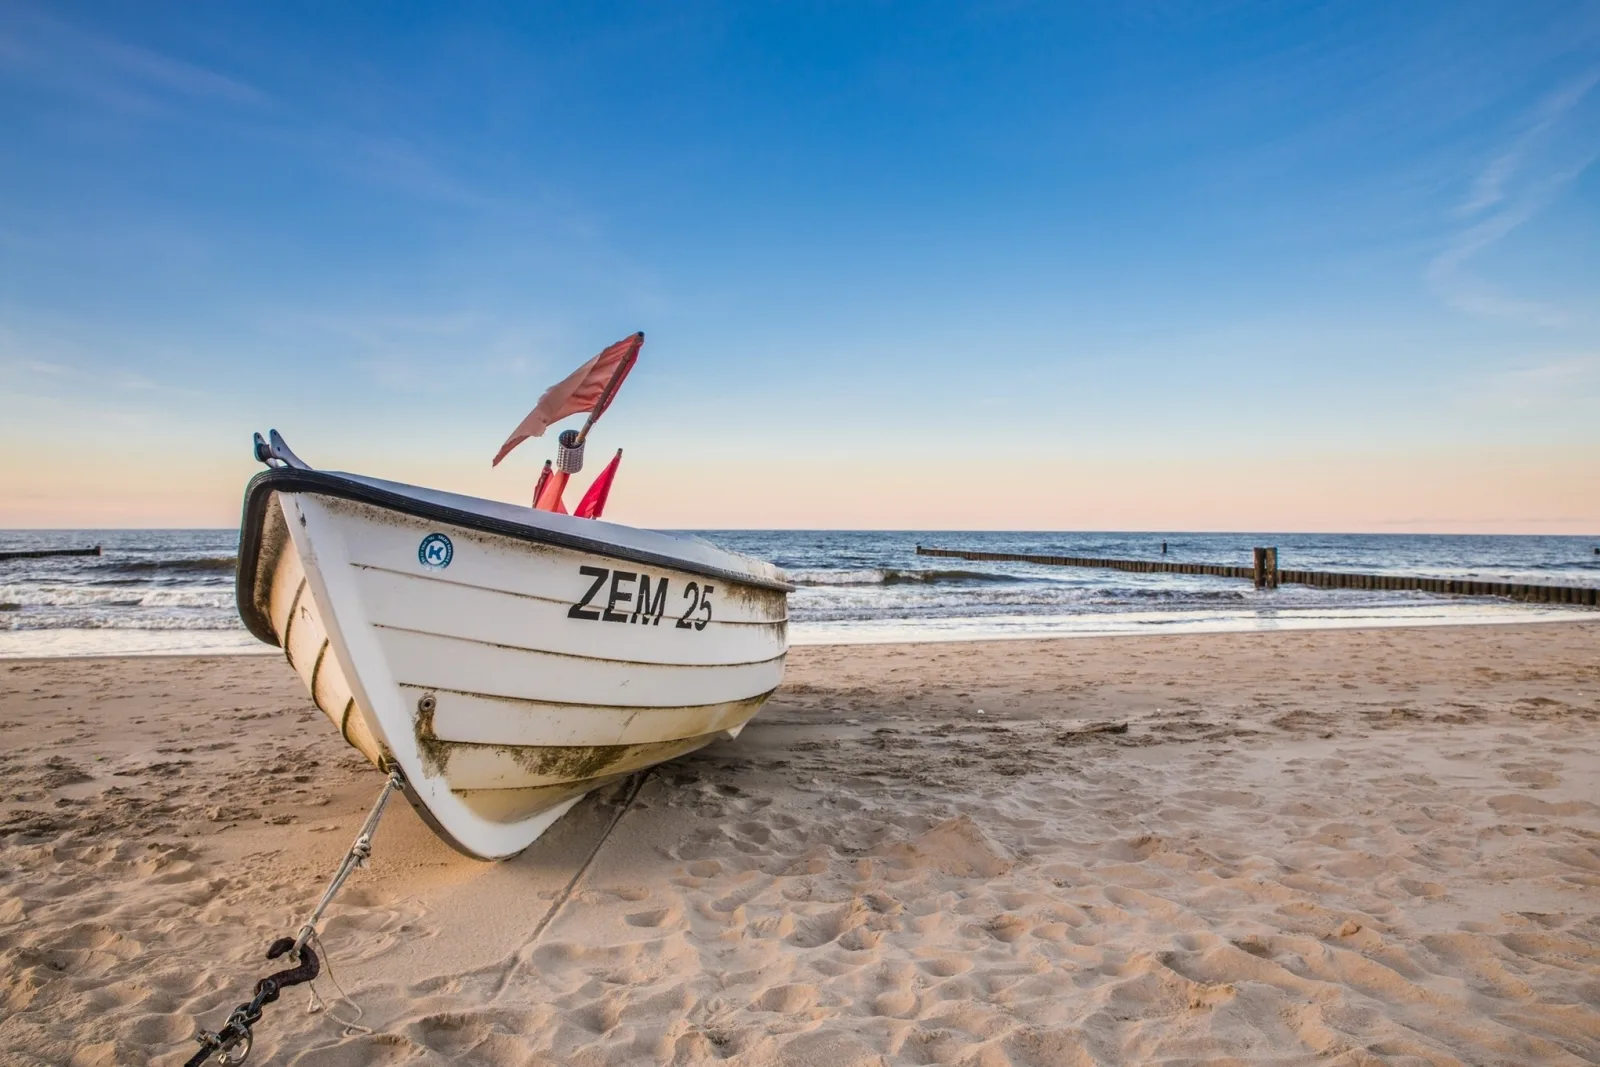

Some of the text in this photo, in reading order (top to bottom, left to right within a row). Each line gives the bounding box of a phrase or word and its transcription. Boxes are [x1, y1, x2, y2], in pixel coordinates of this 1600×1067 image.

[428, 545, 444, 560] K
[567, 565, 714, 631] ZEM 25
